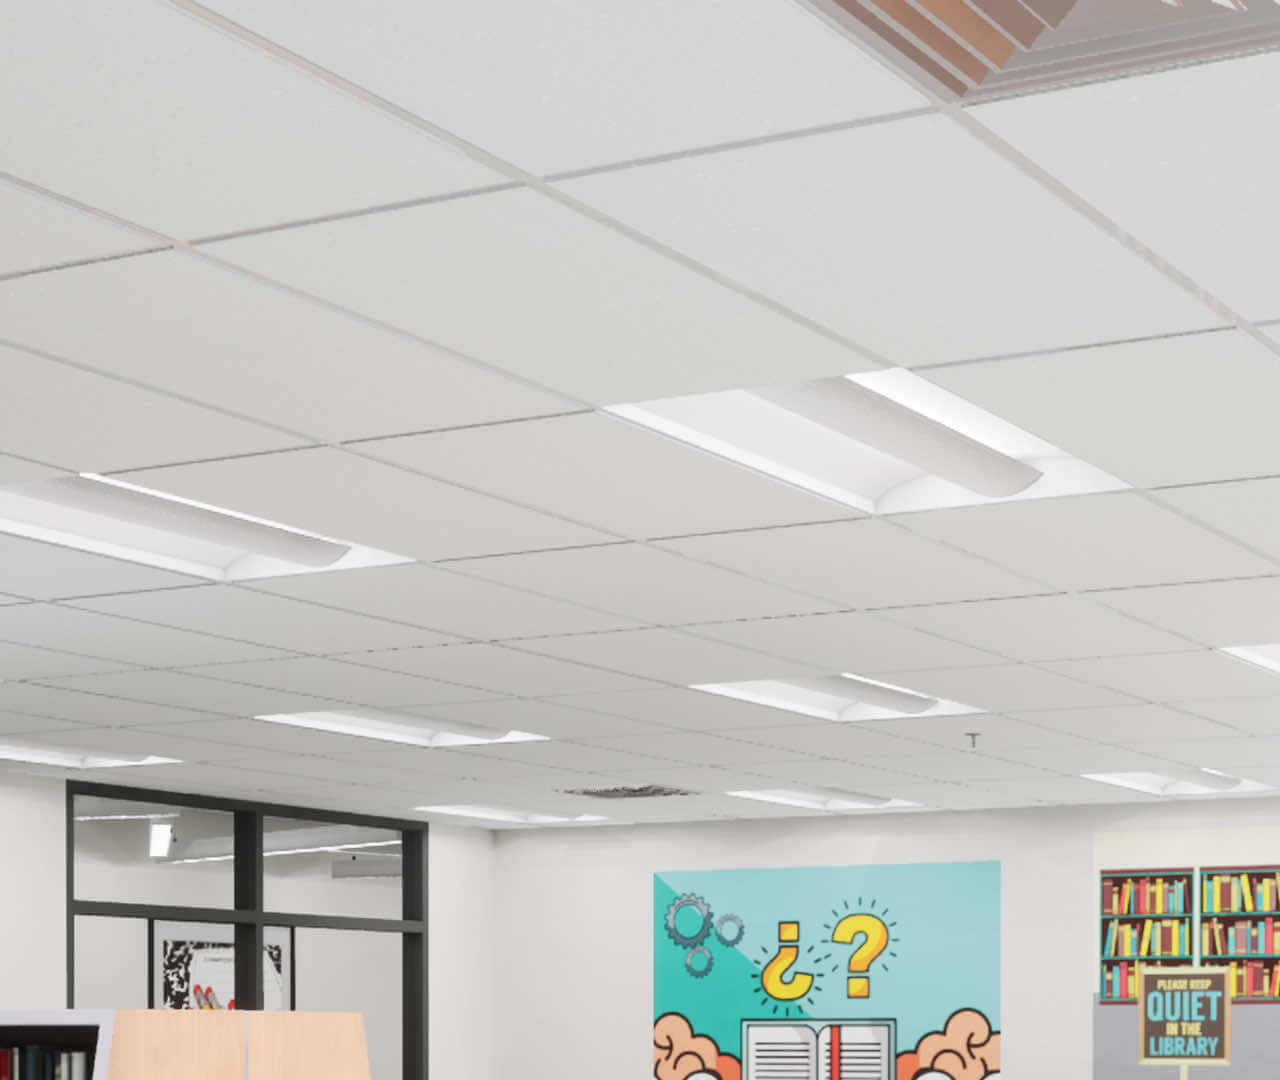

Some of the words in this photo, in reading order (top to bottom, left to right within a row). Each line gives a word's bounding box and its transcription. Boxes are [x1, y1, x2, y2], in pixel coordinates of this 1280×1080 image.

[1147, 990, 1222, 1021] QUIET
[1166, 1022, 1179, 1035] IN
[1180, 1022, 1202, 1035] THE
[1149, 1036, 1219, 1056] LIBRARY
